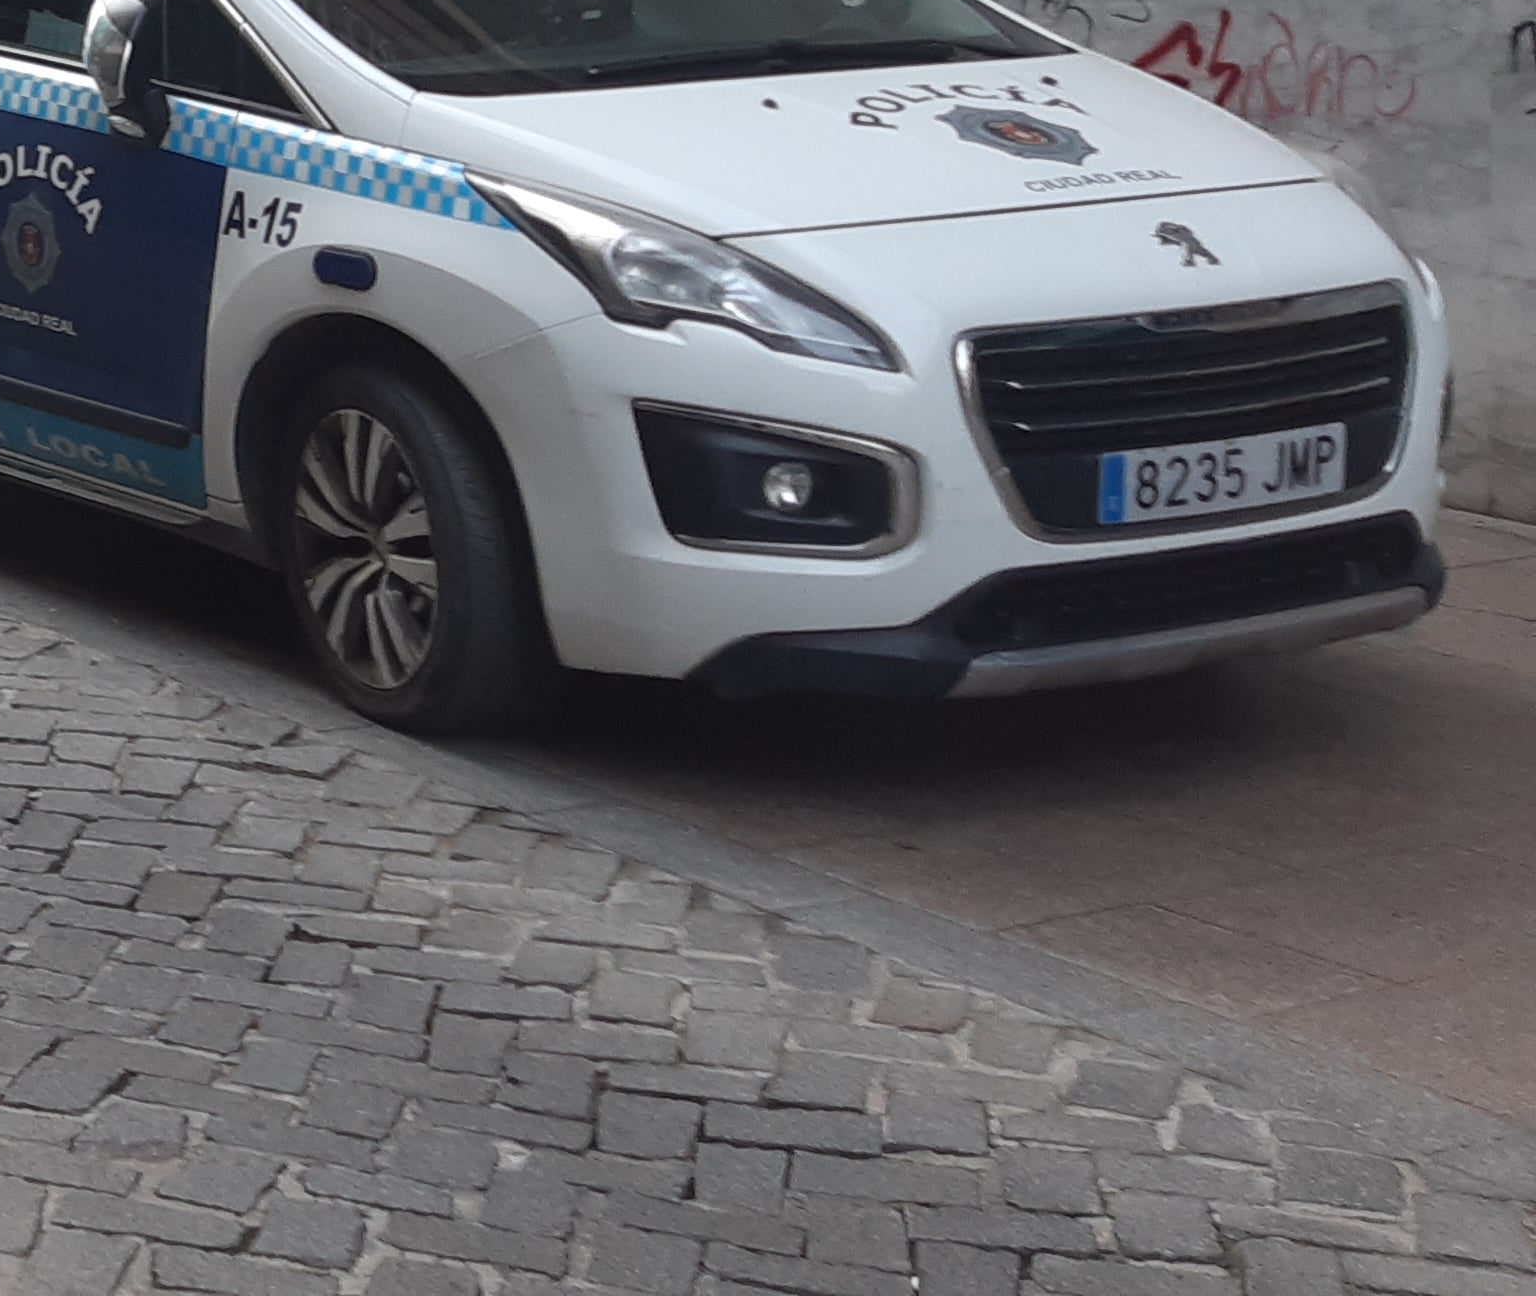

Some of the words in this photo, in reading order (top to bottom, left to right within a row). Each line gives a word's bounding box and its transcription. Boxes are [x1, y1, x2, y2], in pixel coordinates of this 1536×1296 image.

[1024, 171, 1115, 194] CIUDAD
[1117, 169, 1182, 185] REAL
[223, 190, 304, 247] A-15
[40, 312, 79, 337] REAL
[26, 425, 167, 488] LOCAL
[1134, 447, 1246, 510] 8235
[1261, 435, 1337, 493] JMP
